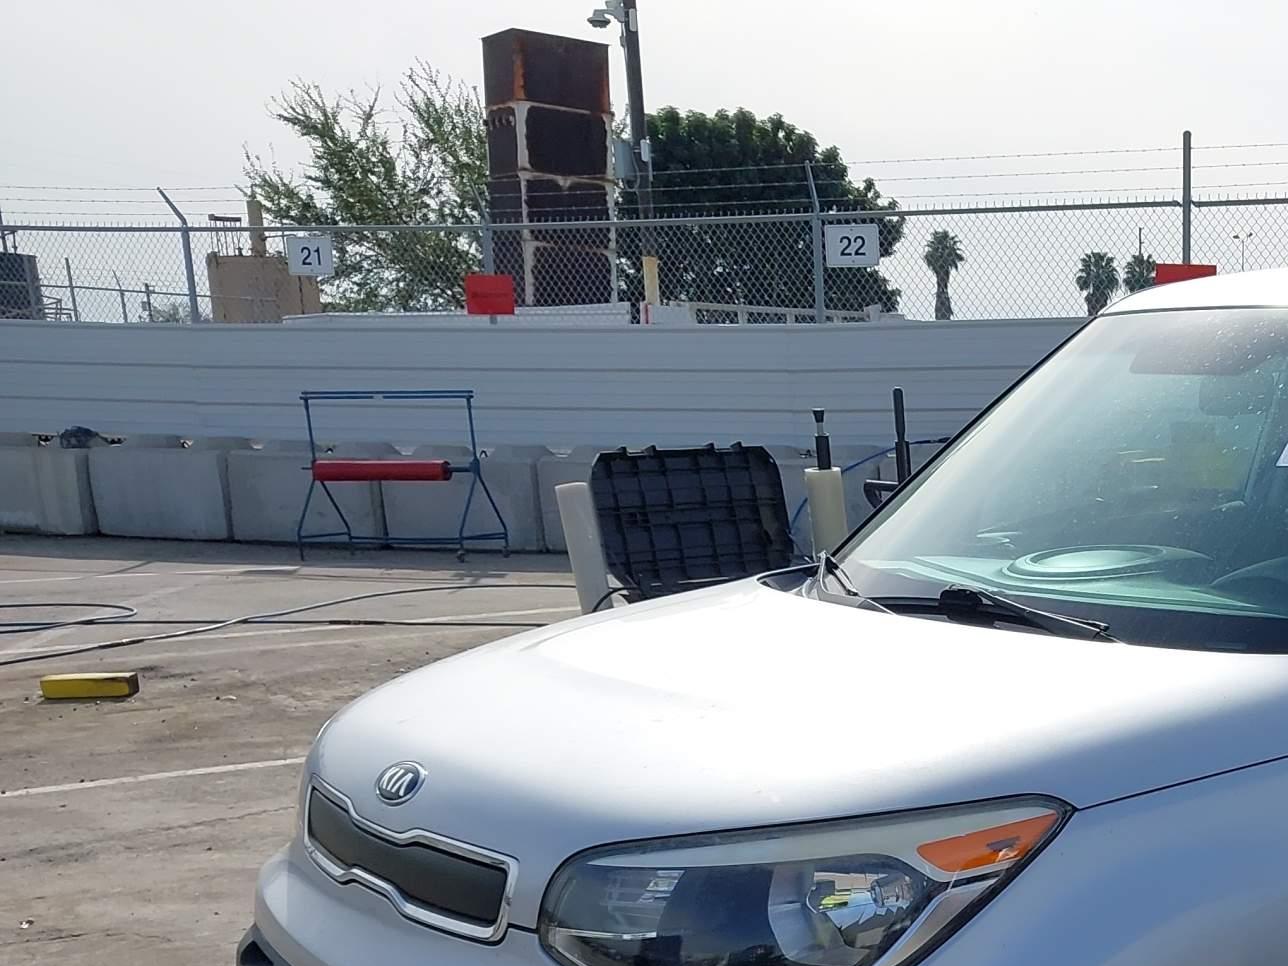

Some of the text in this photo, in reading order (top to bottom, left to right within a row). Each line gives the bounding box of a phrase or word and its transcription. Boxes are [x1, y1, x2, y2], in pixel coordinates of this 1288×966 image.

[300, 246, 321, 266] 21
[839, 235, 866, 256] 22
[379, 766, 415, 797] KIA
